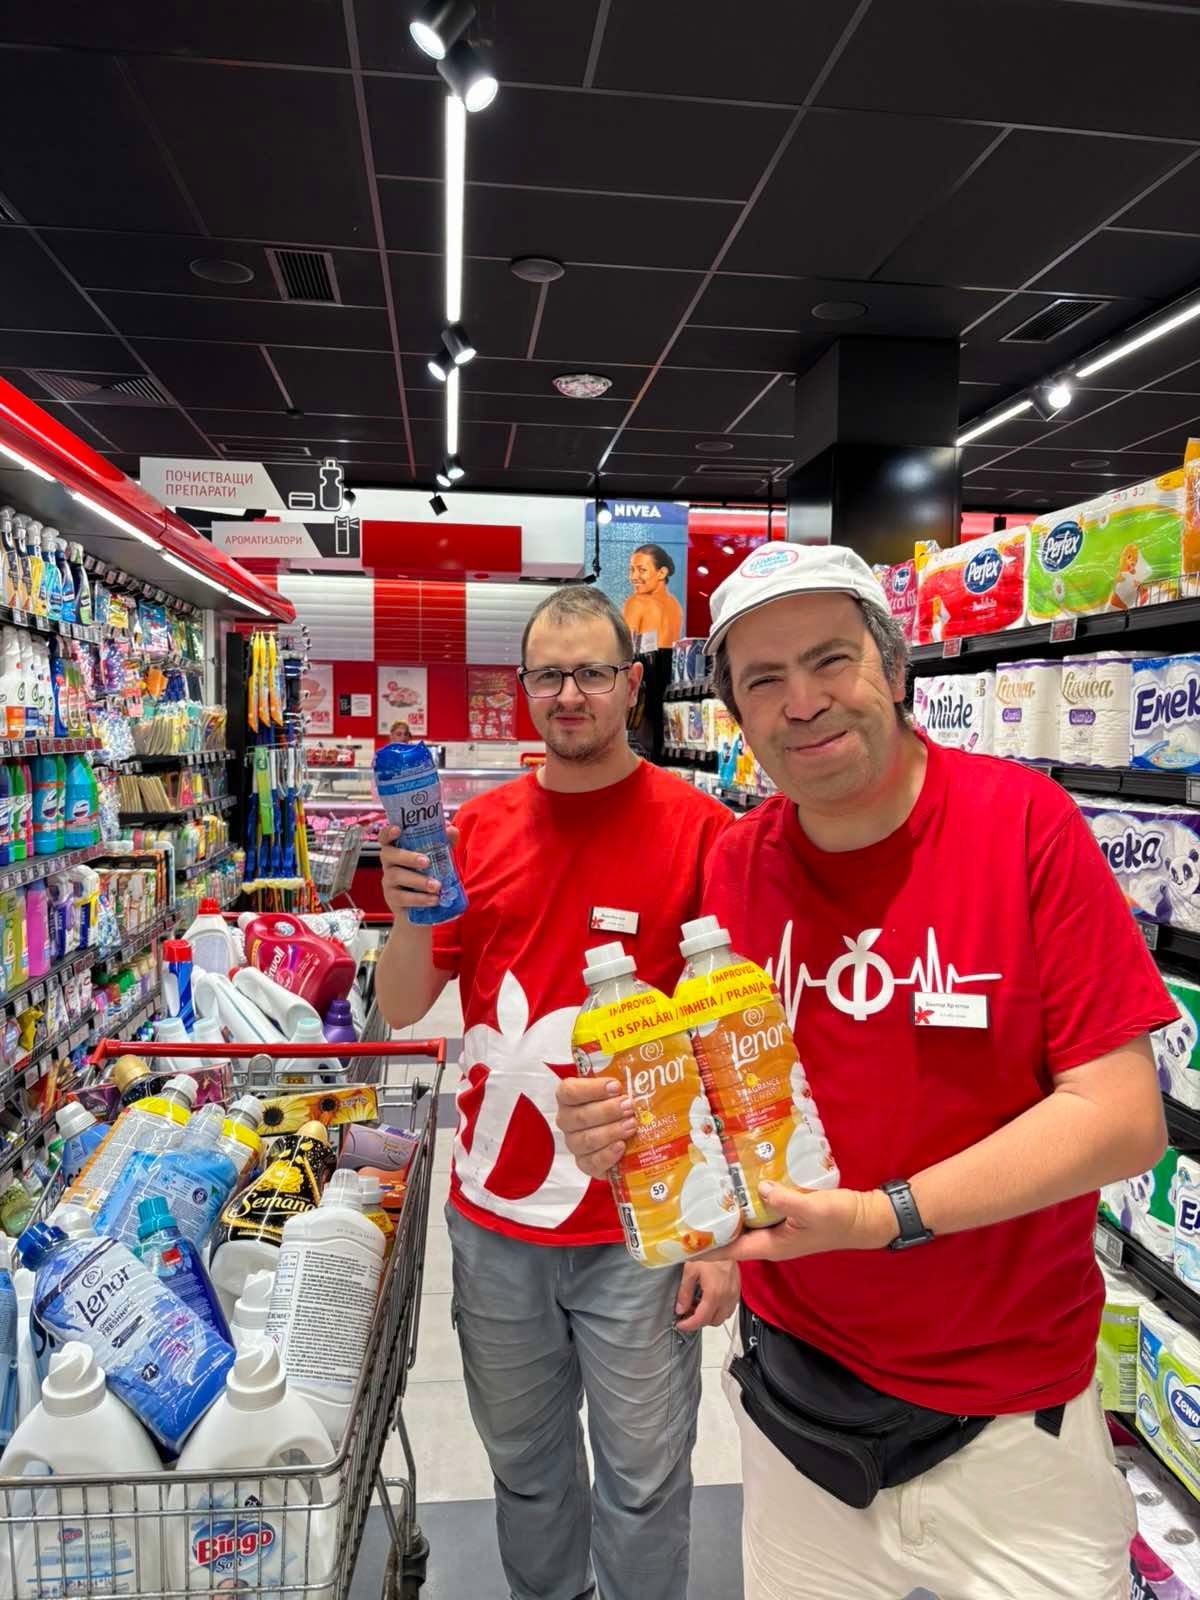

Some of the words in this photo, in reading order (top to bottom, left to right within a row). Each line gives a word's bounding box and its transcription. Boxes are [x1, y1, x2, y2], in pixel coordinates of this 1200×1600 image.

[165, 470, 254, 486] ПОЧИСТВАЩИ
[165, 483, 237, 497] ПРЕПАРАТИ
[614, 503, 662, 518] NIVEA
[225, 535, 303, 545] АРОМАТИЗАТОРИ
[1044, 530, 1081, 567] Perfex
[967, 553, 999, 585] Perfex
[927, 694, 973, 729] Milde
[400, 801, 440, 830] Lenor
[712, 964, 756, 984] IMPROVED
[603, 1021, 625, 1043] 118
[727, 981, 768, 1002] PRANJA
[609, 995, 656, 1017] IMPROVED
[729, 1022, 789, 1069] Lenor
[624, 1055, 687, 1103] Lenor
[652, 1183, 666, 1197] 59
[75, 1264, 130, 1328] Lenor
[197, 1530, 273, 1566] Bingo
